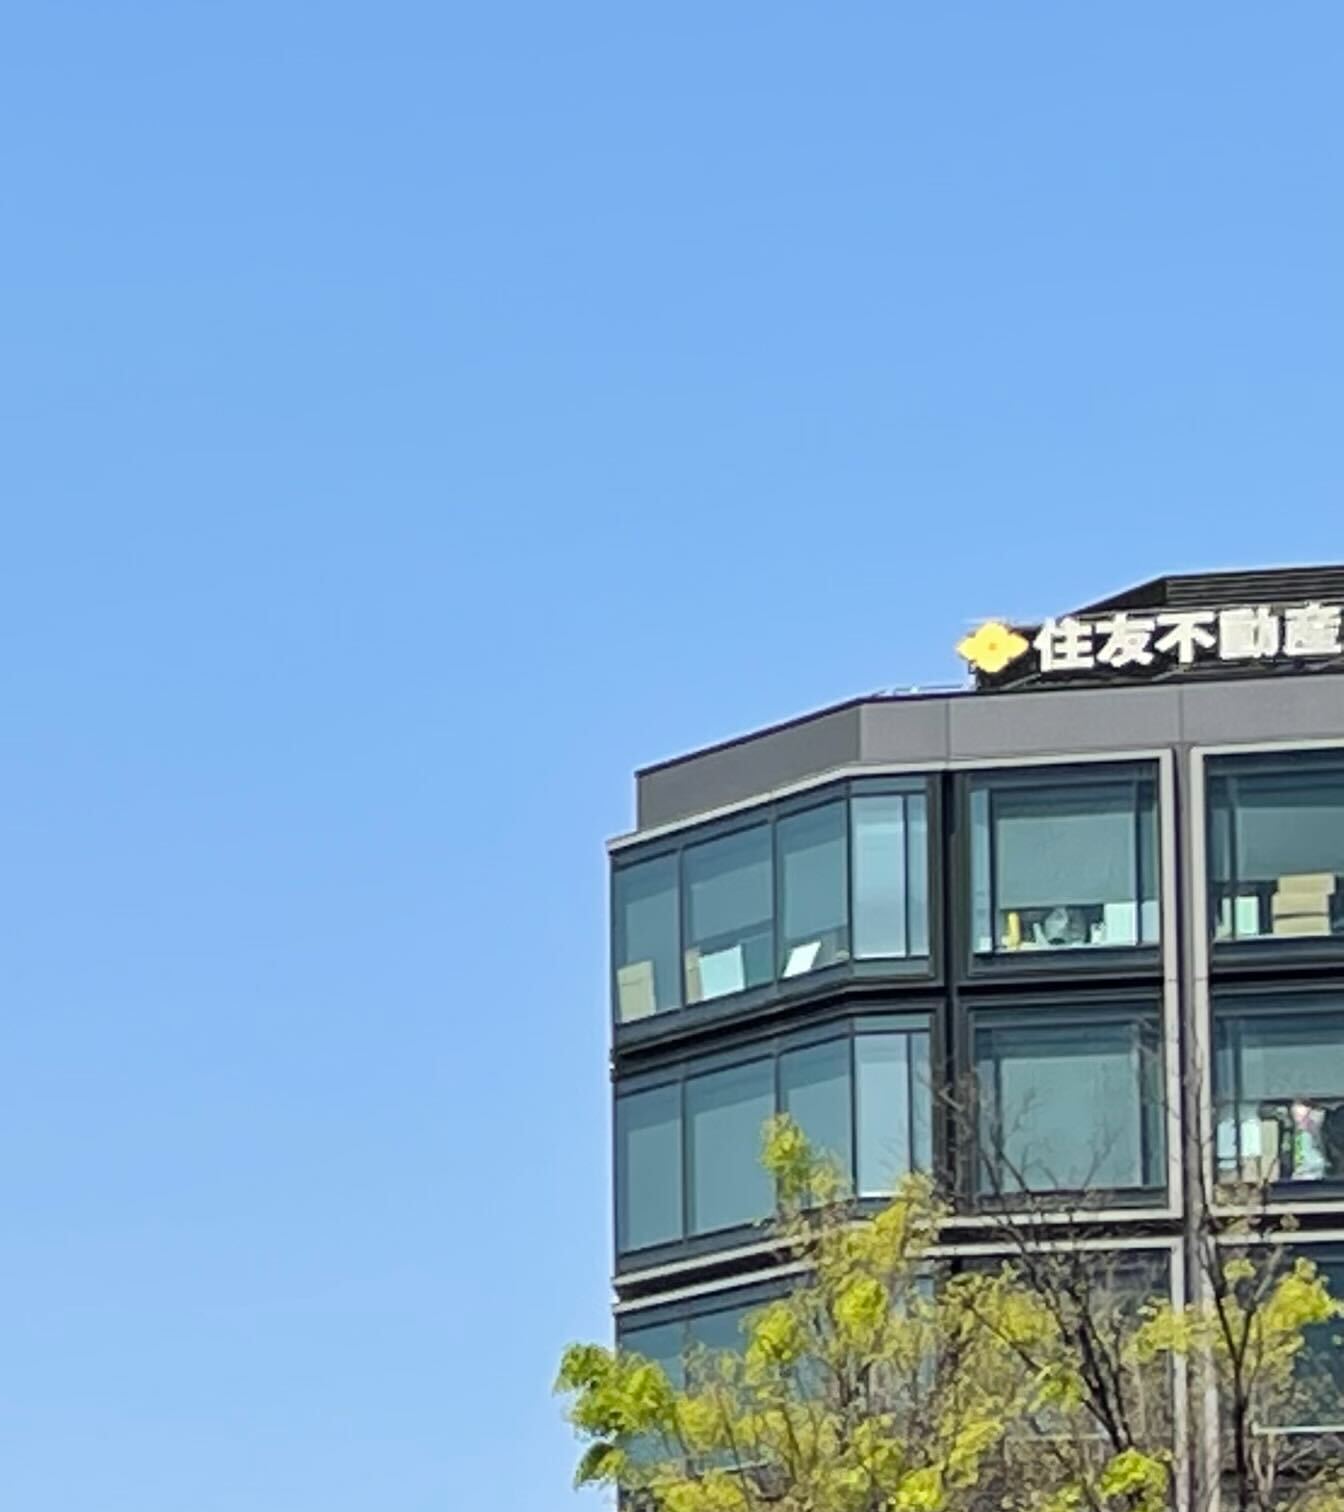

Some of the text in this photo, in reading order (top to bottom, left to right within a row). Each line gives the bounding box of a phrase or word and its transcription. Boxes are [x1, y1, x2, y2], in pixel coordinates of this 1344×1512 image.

[1033, 602, 1341, 672] 住友不動産
